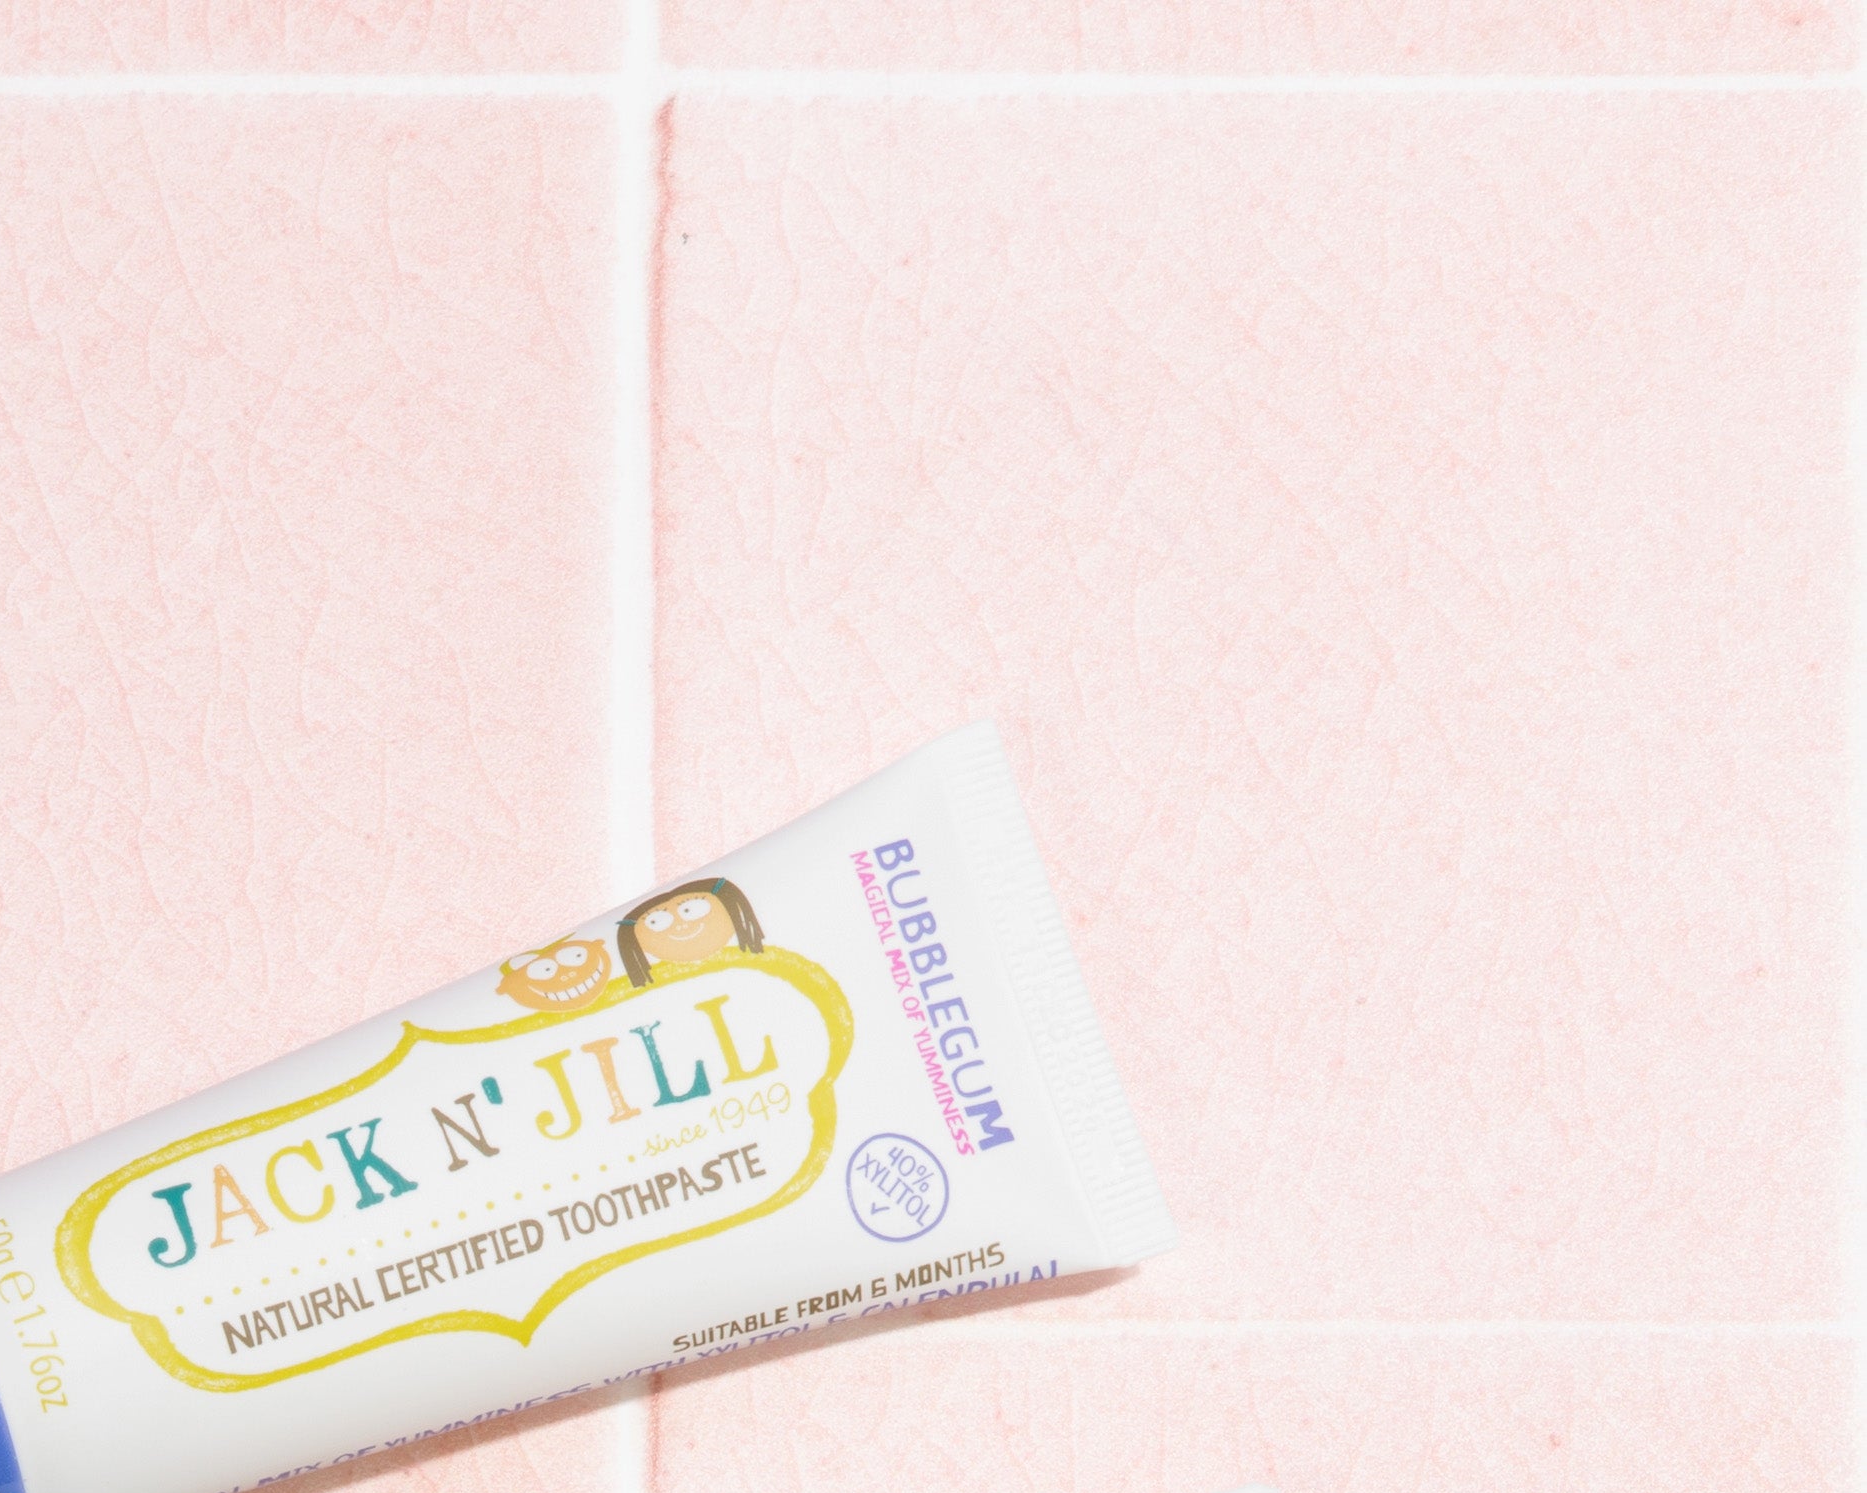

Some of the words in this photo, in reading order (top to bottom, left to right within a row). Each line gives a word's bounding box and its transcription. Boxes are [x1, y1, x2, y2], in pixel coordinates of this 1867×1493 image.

[850, 851, 895, 944] MAGICAL
[885, 949, 912, 992] MIX
[902, 996, 926, 1022] OF
[914, 1028, 975, 1155] YUMMINESS
[873, 838, 1015, 1151] BUBBLEGUM
[147, 1118, 418, 1268] JACK
[431, 1076, 503, 1172] N'
[535, 996, 774, 1140] JILL
[643, 1124, 708, 1157] since
[700, 1081, 792, 1134] 1949
[888, 1146, 934, 1193] 40%
[854, 1153, 931, 1228] XYLITOL
[221, 1277, 375, 1355] NATURAL
[376, 1219, 544, 1302] CERTIFIED
[547, 1143, 766, 1241] TOOTHPASTE
[673, 1307, 788, 1353] SUITABLE
[797, 1284, 862, 1318] FROM
[871, 1278, 887, 1299] 6
[895, 1243, 1004, 1292] MONTHS
[13, 1304, 69, 1414] 1.76oz
